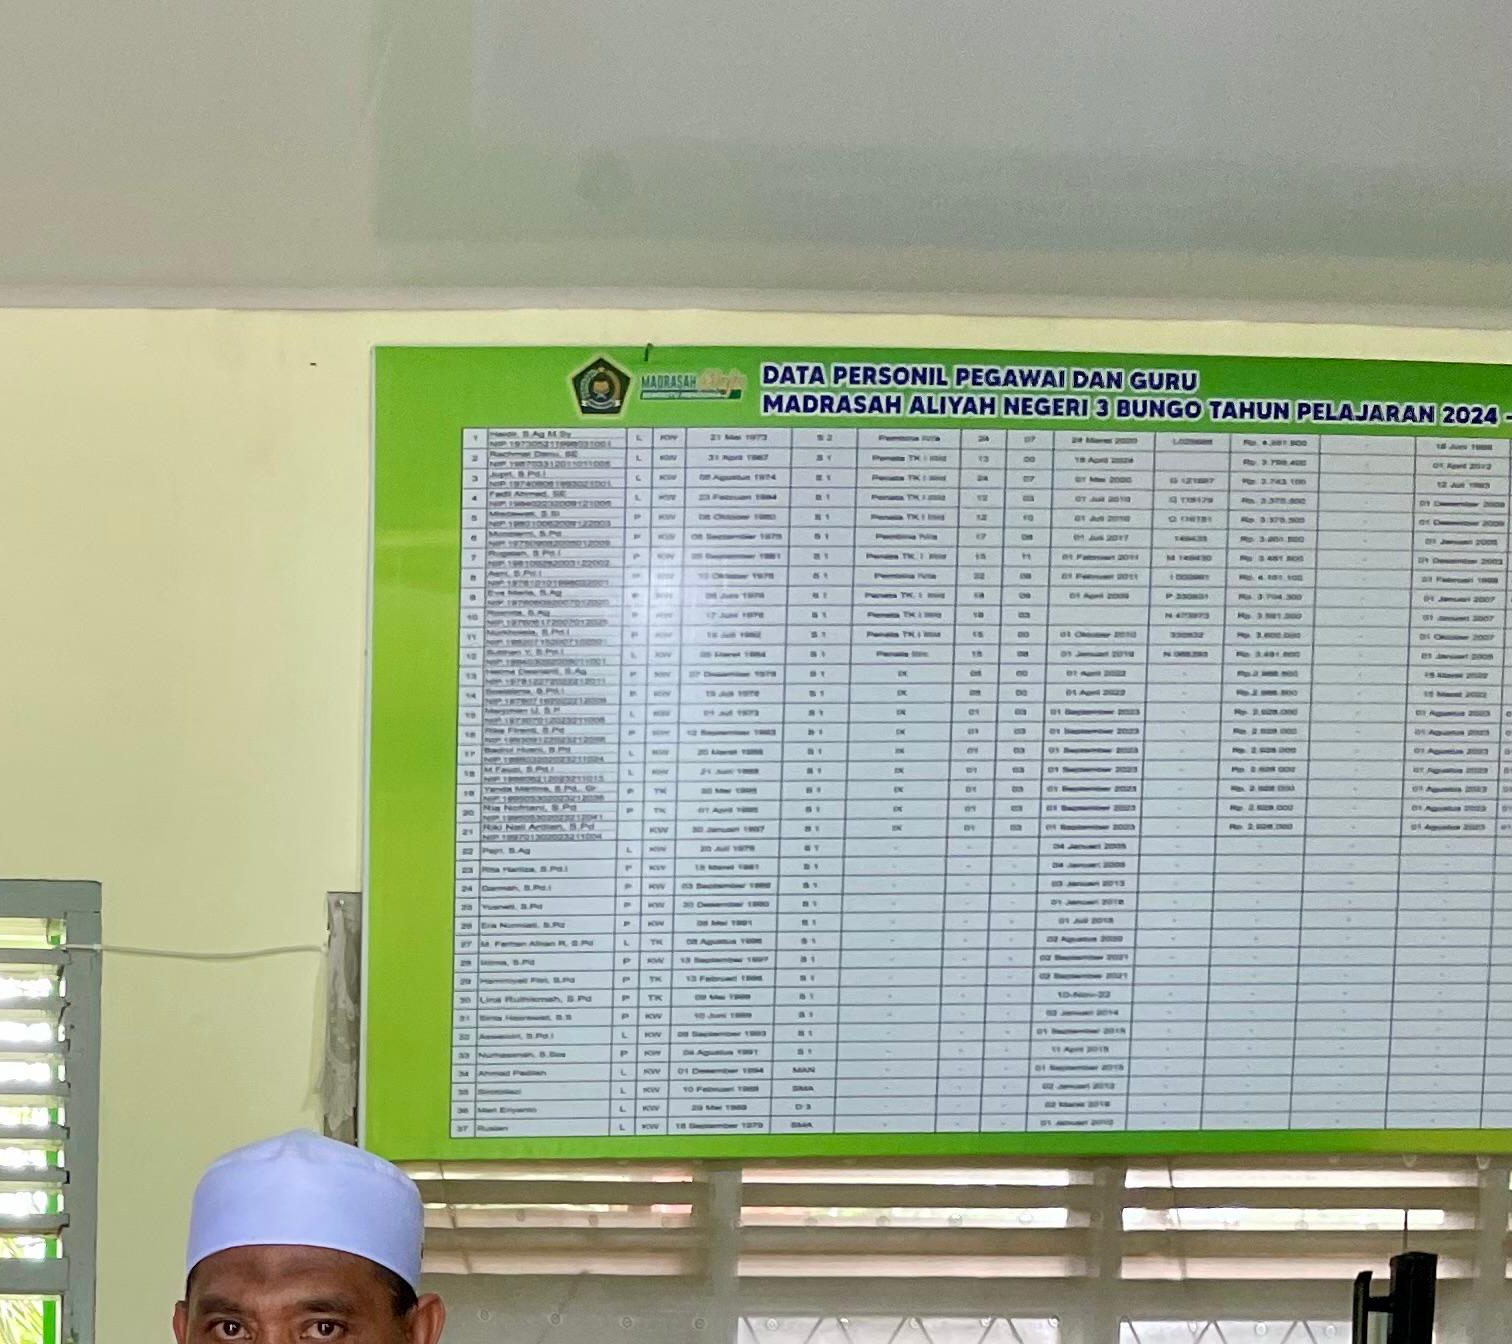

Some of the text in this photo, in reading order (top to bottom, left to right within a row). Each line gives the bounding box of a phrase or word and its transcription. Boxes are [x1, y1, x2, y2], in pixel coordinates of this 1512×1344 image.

[763, 366, 824, 385] DATA
[834, 366, 947, 387] PERSONIL
[956, 368, 1065, 388] PEGAWAI
[1072, 371, 1123, 390] DAN
[1130, 371, 1197, 391] GURU
[763, 394, 904, 414] MADRASAH
[909, 395, 995, 416] ALIYAH
[1004, 397, 1089, 416] NEGERI
[1095, 400, 1109, 417] 3
[1117, 400, 1202, 419] BUNGO
[1211, 401, 1289, 420] TAHUN
[1297, 403, 1435, 423] PELAJARAN
[1443, 406, 1497, 424] 2024
